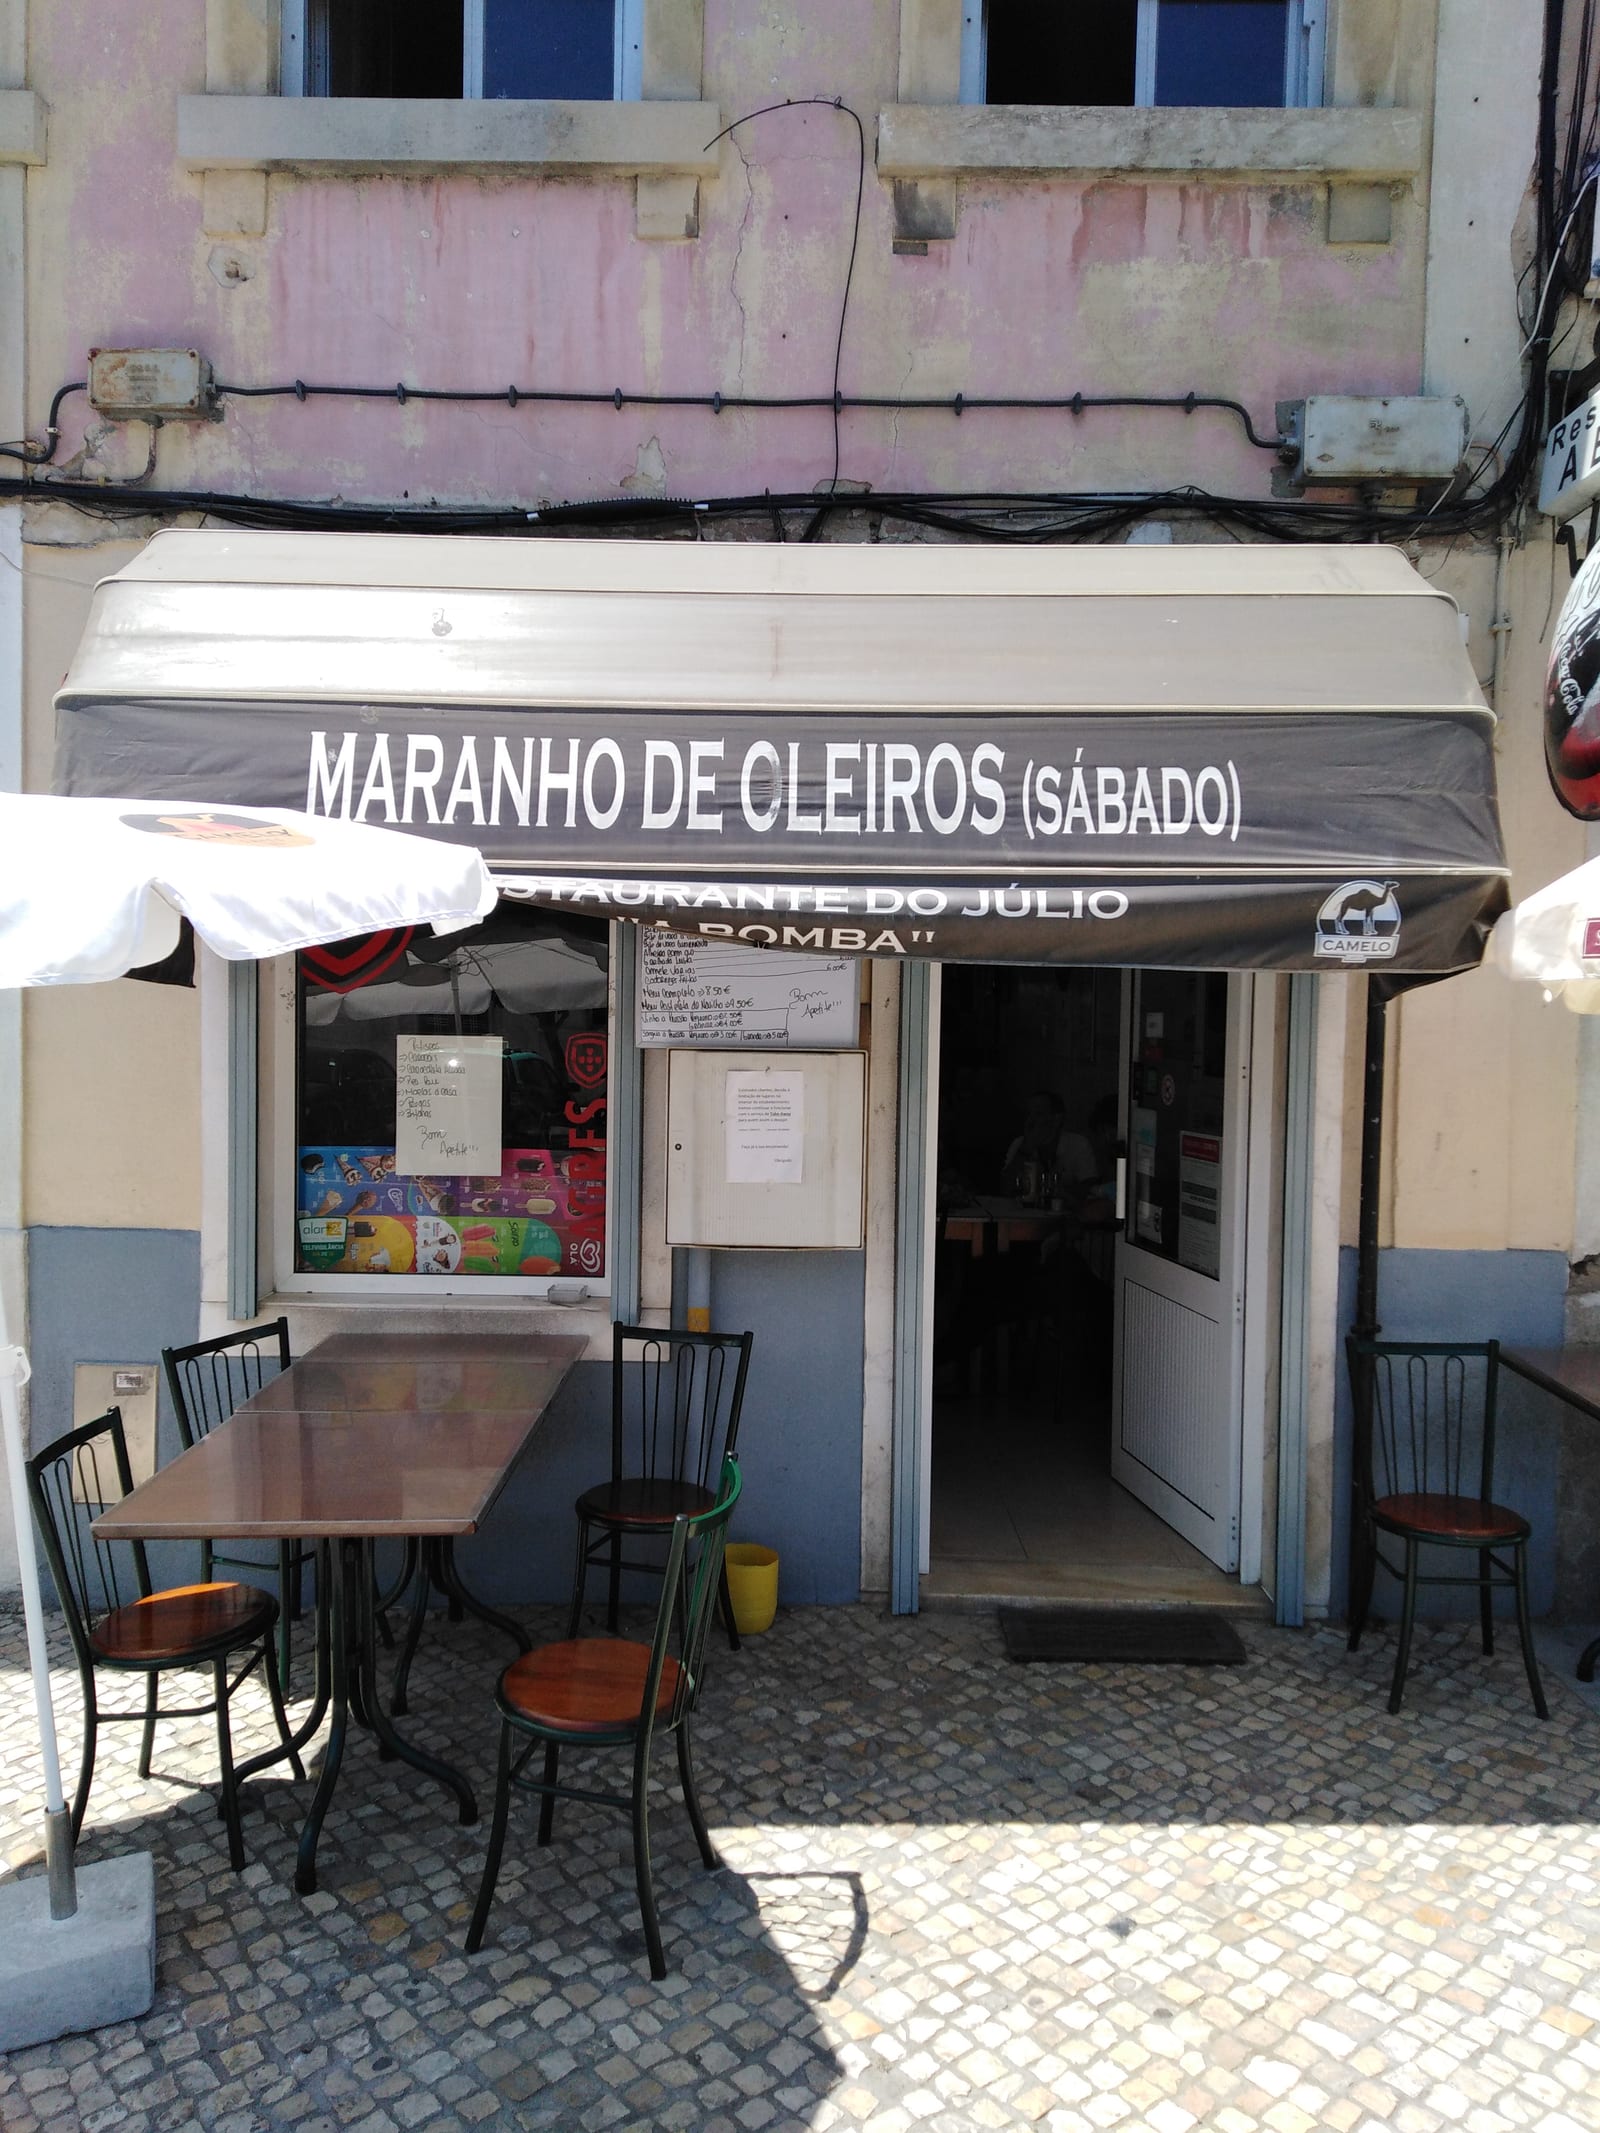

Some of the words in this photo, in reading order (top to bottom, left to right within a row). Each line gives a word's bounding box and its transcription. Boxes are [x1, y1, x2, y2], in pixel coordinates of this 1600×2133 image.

[306, 731, 625, 829] MARANHO
[641, 737, 724, 833] DE
[741, 739, 1005, 835] OLEIROS
[1022, 748, 1240, 841] (SÁBADO)
[865, 887, 948, 915] DO
[961, 883, 1129, 919] JÚLIO
[1322, 939, 1391, 953] CAMELO
